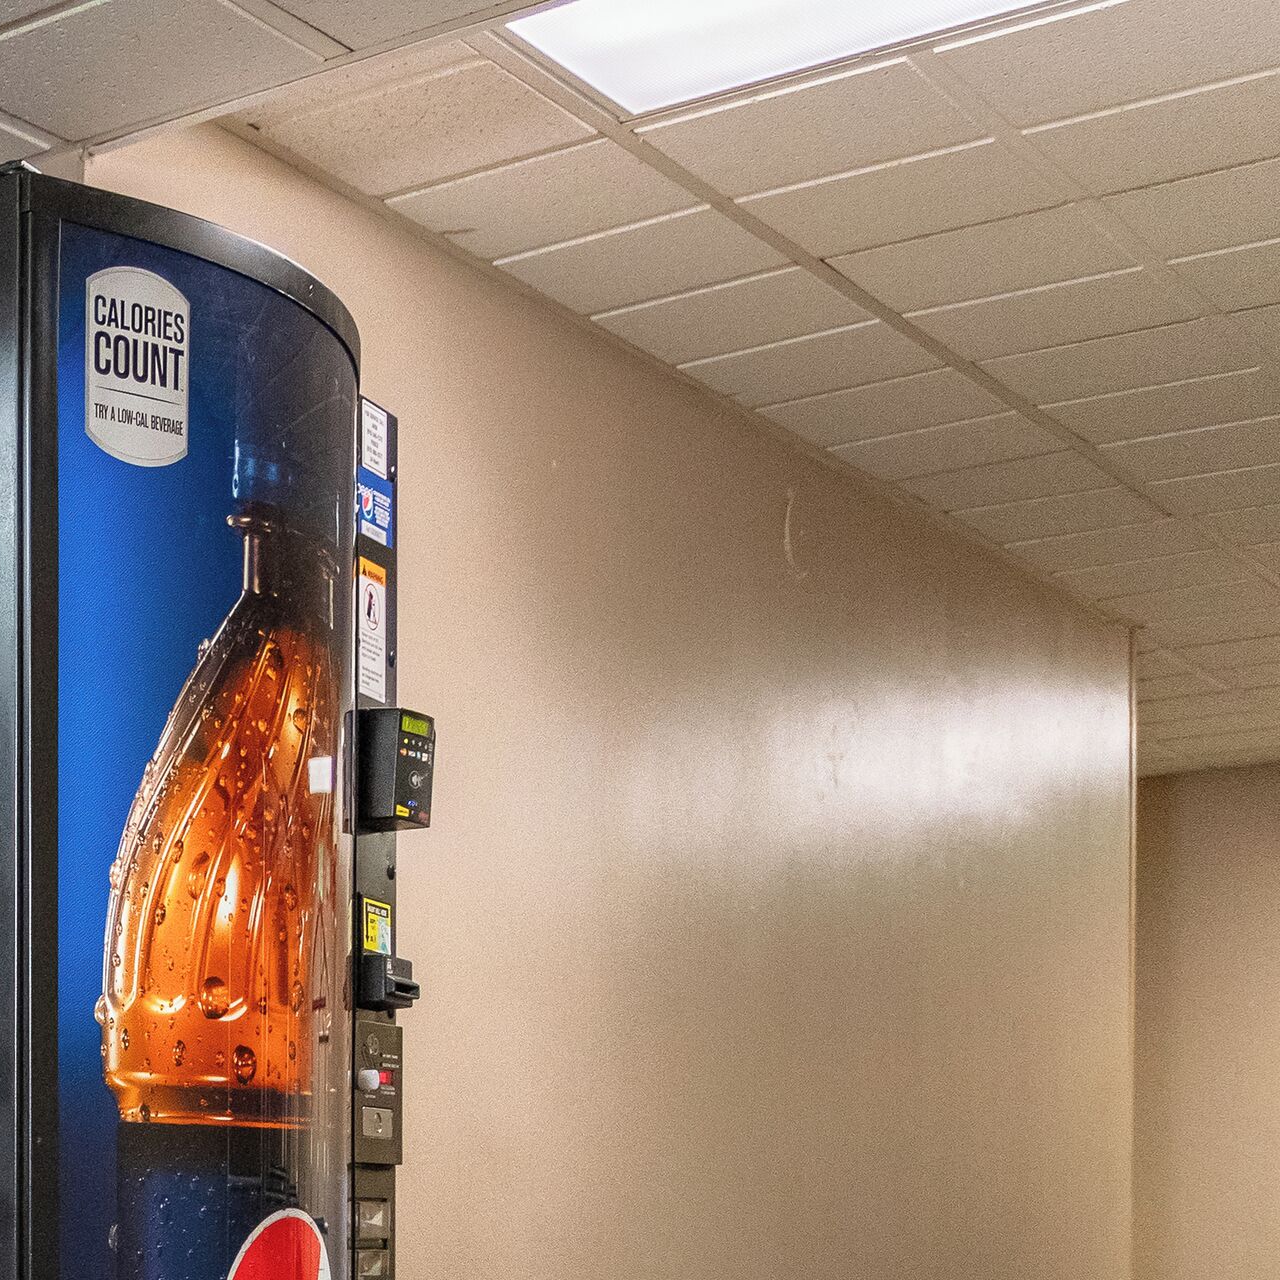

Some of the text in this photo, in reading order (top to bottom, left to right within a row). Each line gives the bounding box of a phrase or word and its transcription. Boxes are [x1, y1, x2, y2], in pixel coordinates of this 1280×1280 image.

[94, 294, 185, 345] CALORIES
[94, 330, 185, 392] COUNT
[94, 402, 184, 437] TRY A LOW-CAL BEVERAGE
